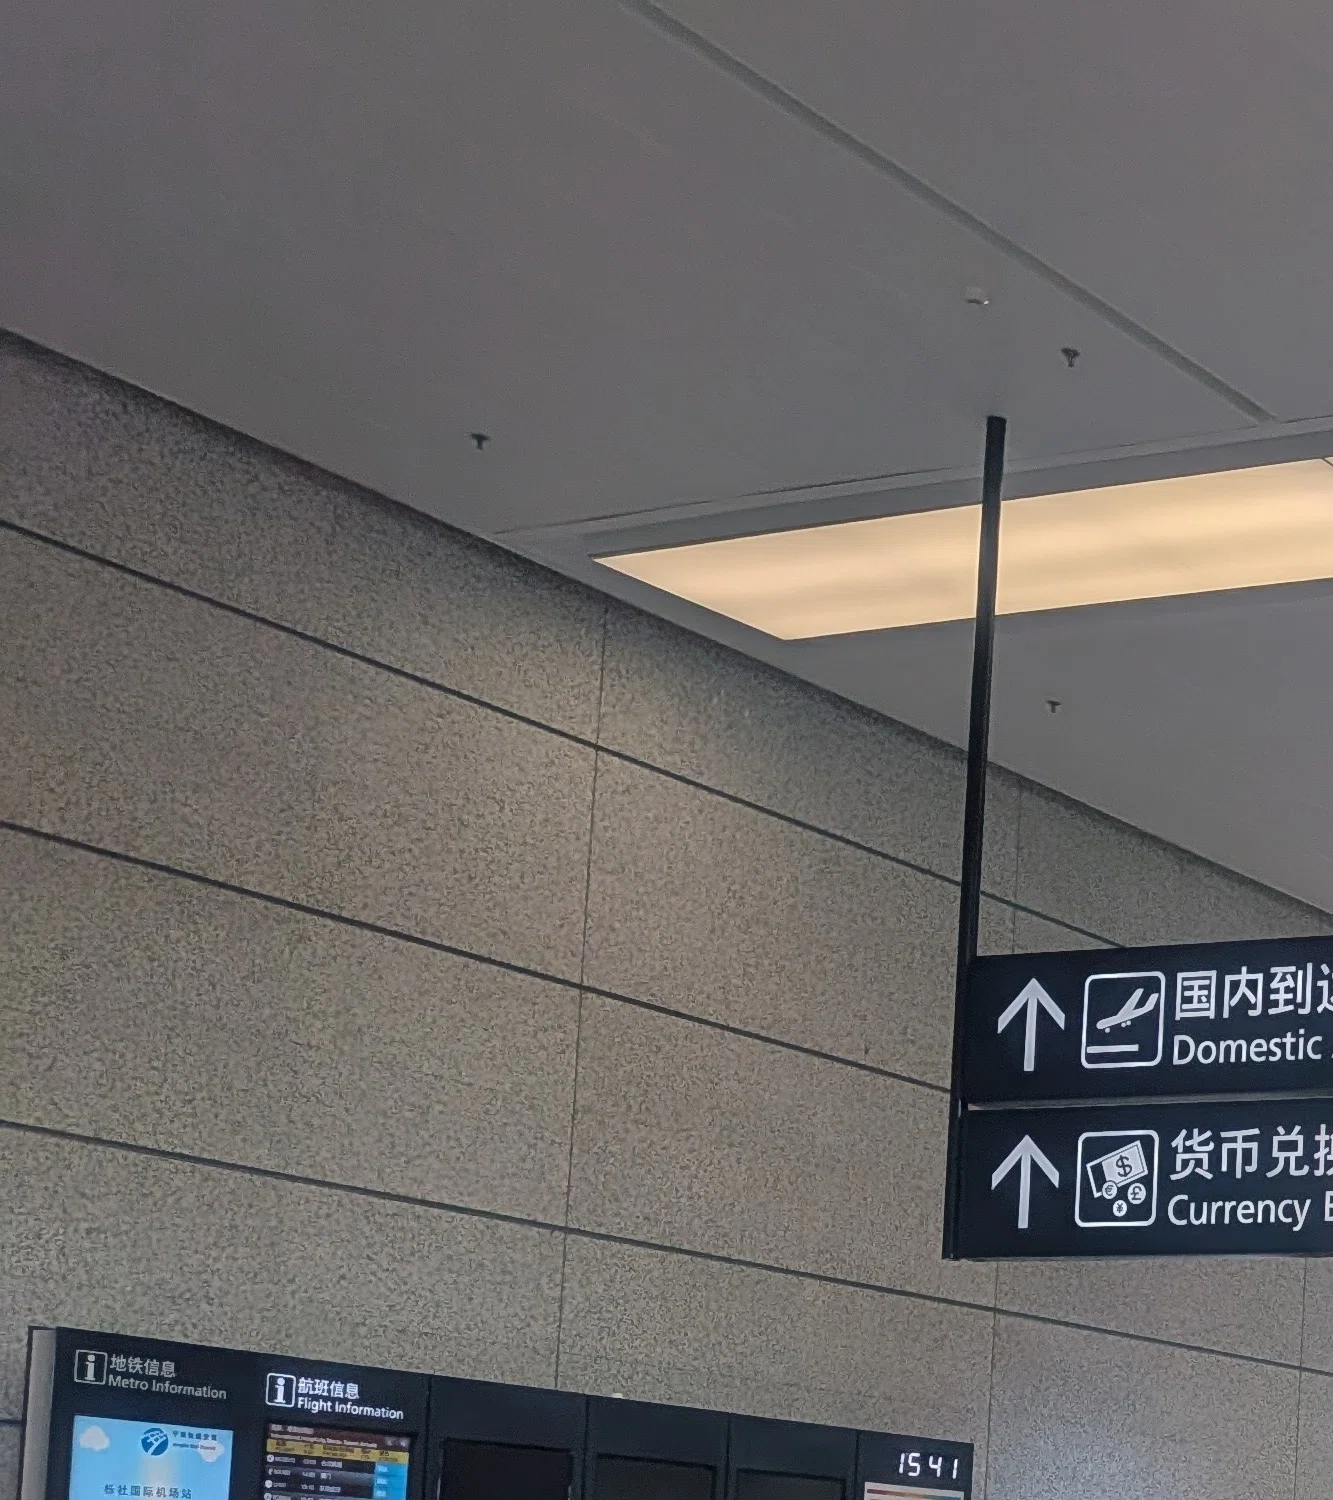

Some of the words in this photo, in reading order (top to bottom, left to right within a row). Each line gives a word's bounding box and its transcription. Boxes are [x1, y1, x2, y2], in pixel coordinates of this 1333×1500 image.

[1173, 1029, 1322, 1065] Domestic
[1168, 1195, 1311, 1231] Currency
[110, 1353, 176, 1378] 地铁信息
[108, 1374, 149, 1391] Metro
[152, 1380, 227, 1400] Information
[298, 1377, 360, 1399] 航班信息
[298, 1397, 332, 1413] Flight
[335, 1401, 404, 1419] Information
